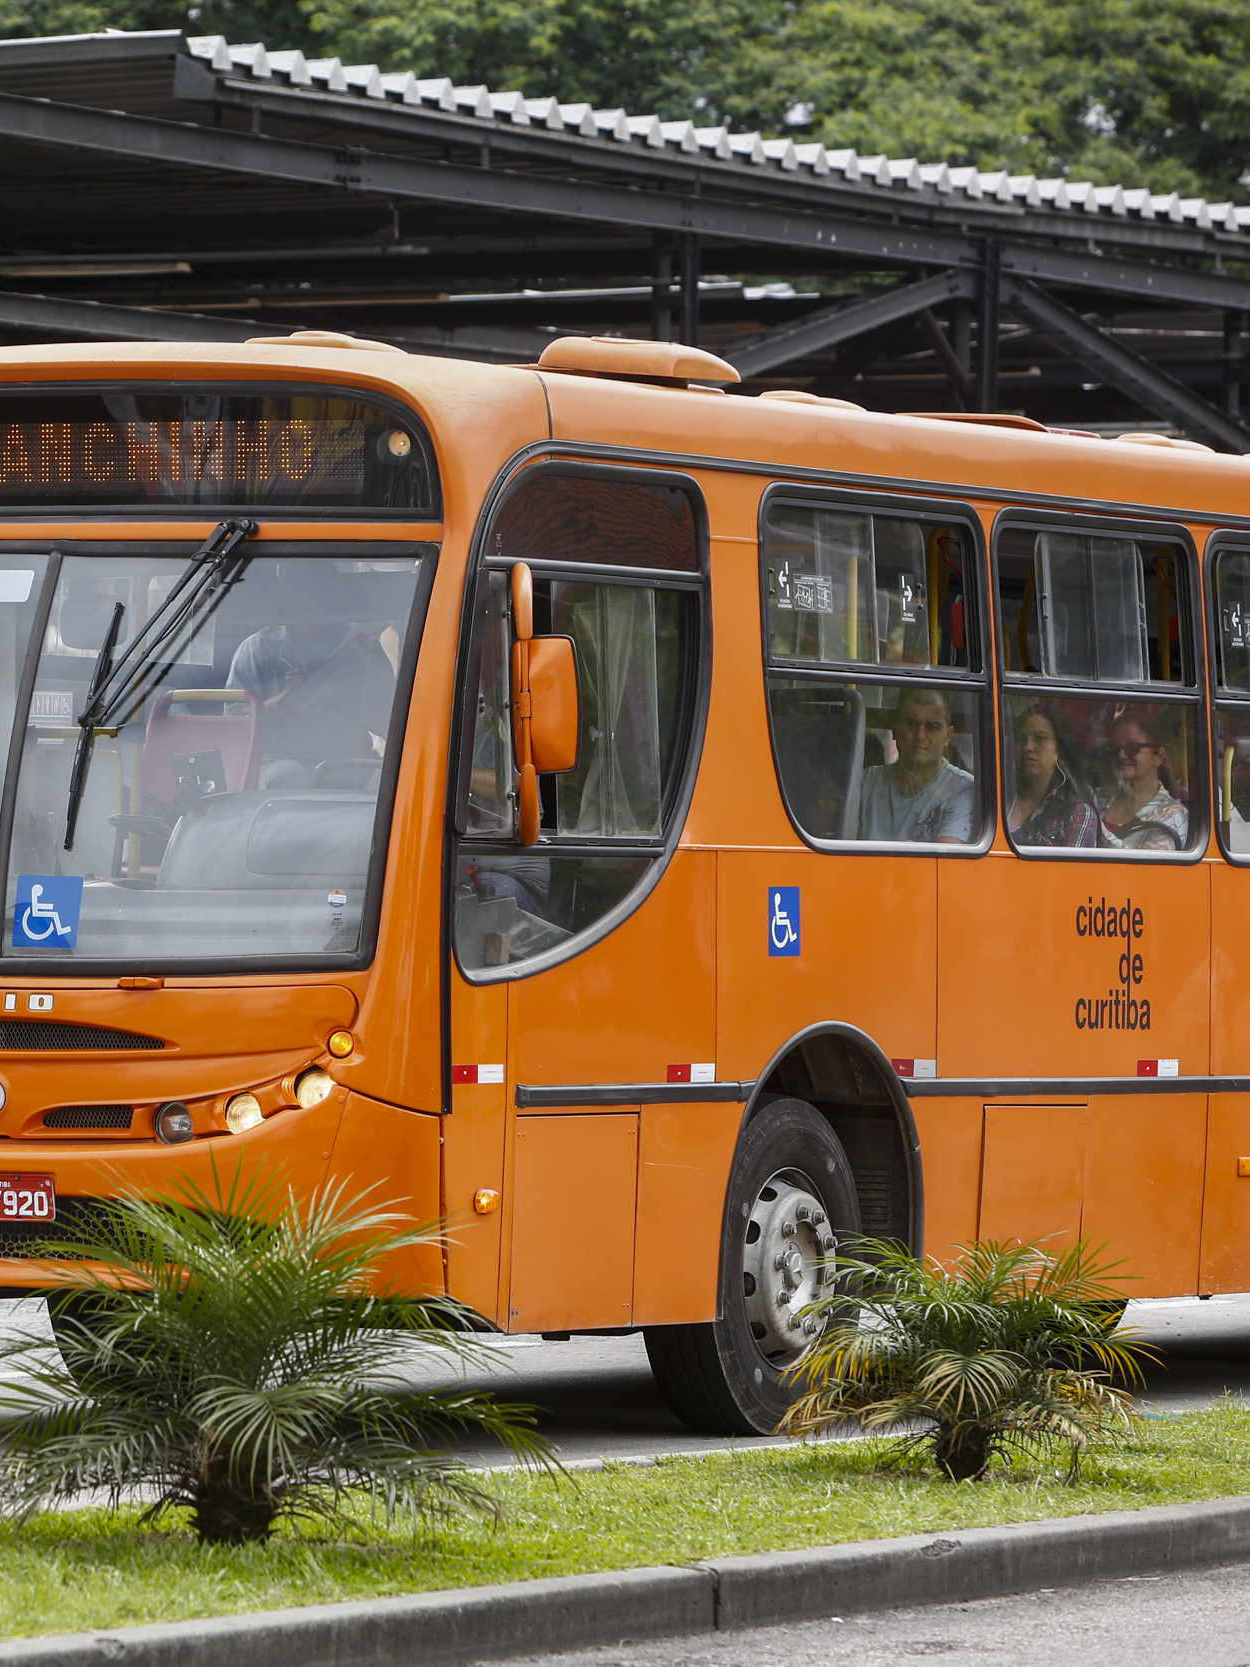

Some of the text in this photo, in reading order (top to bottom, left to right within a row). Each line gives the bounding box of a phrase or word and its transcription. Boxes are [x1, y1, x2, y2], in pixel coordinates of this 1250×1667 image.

[1076, 896, 1144, 939] cidade
[1119, 953, 1144, 985] de
[1075, 989, 1151, 1030] curitiba
